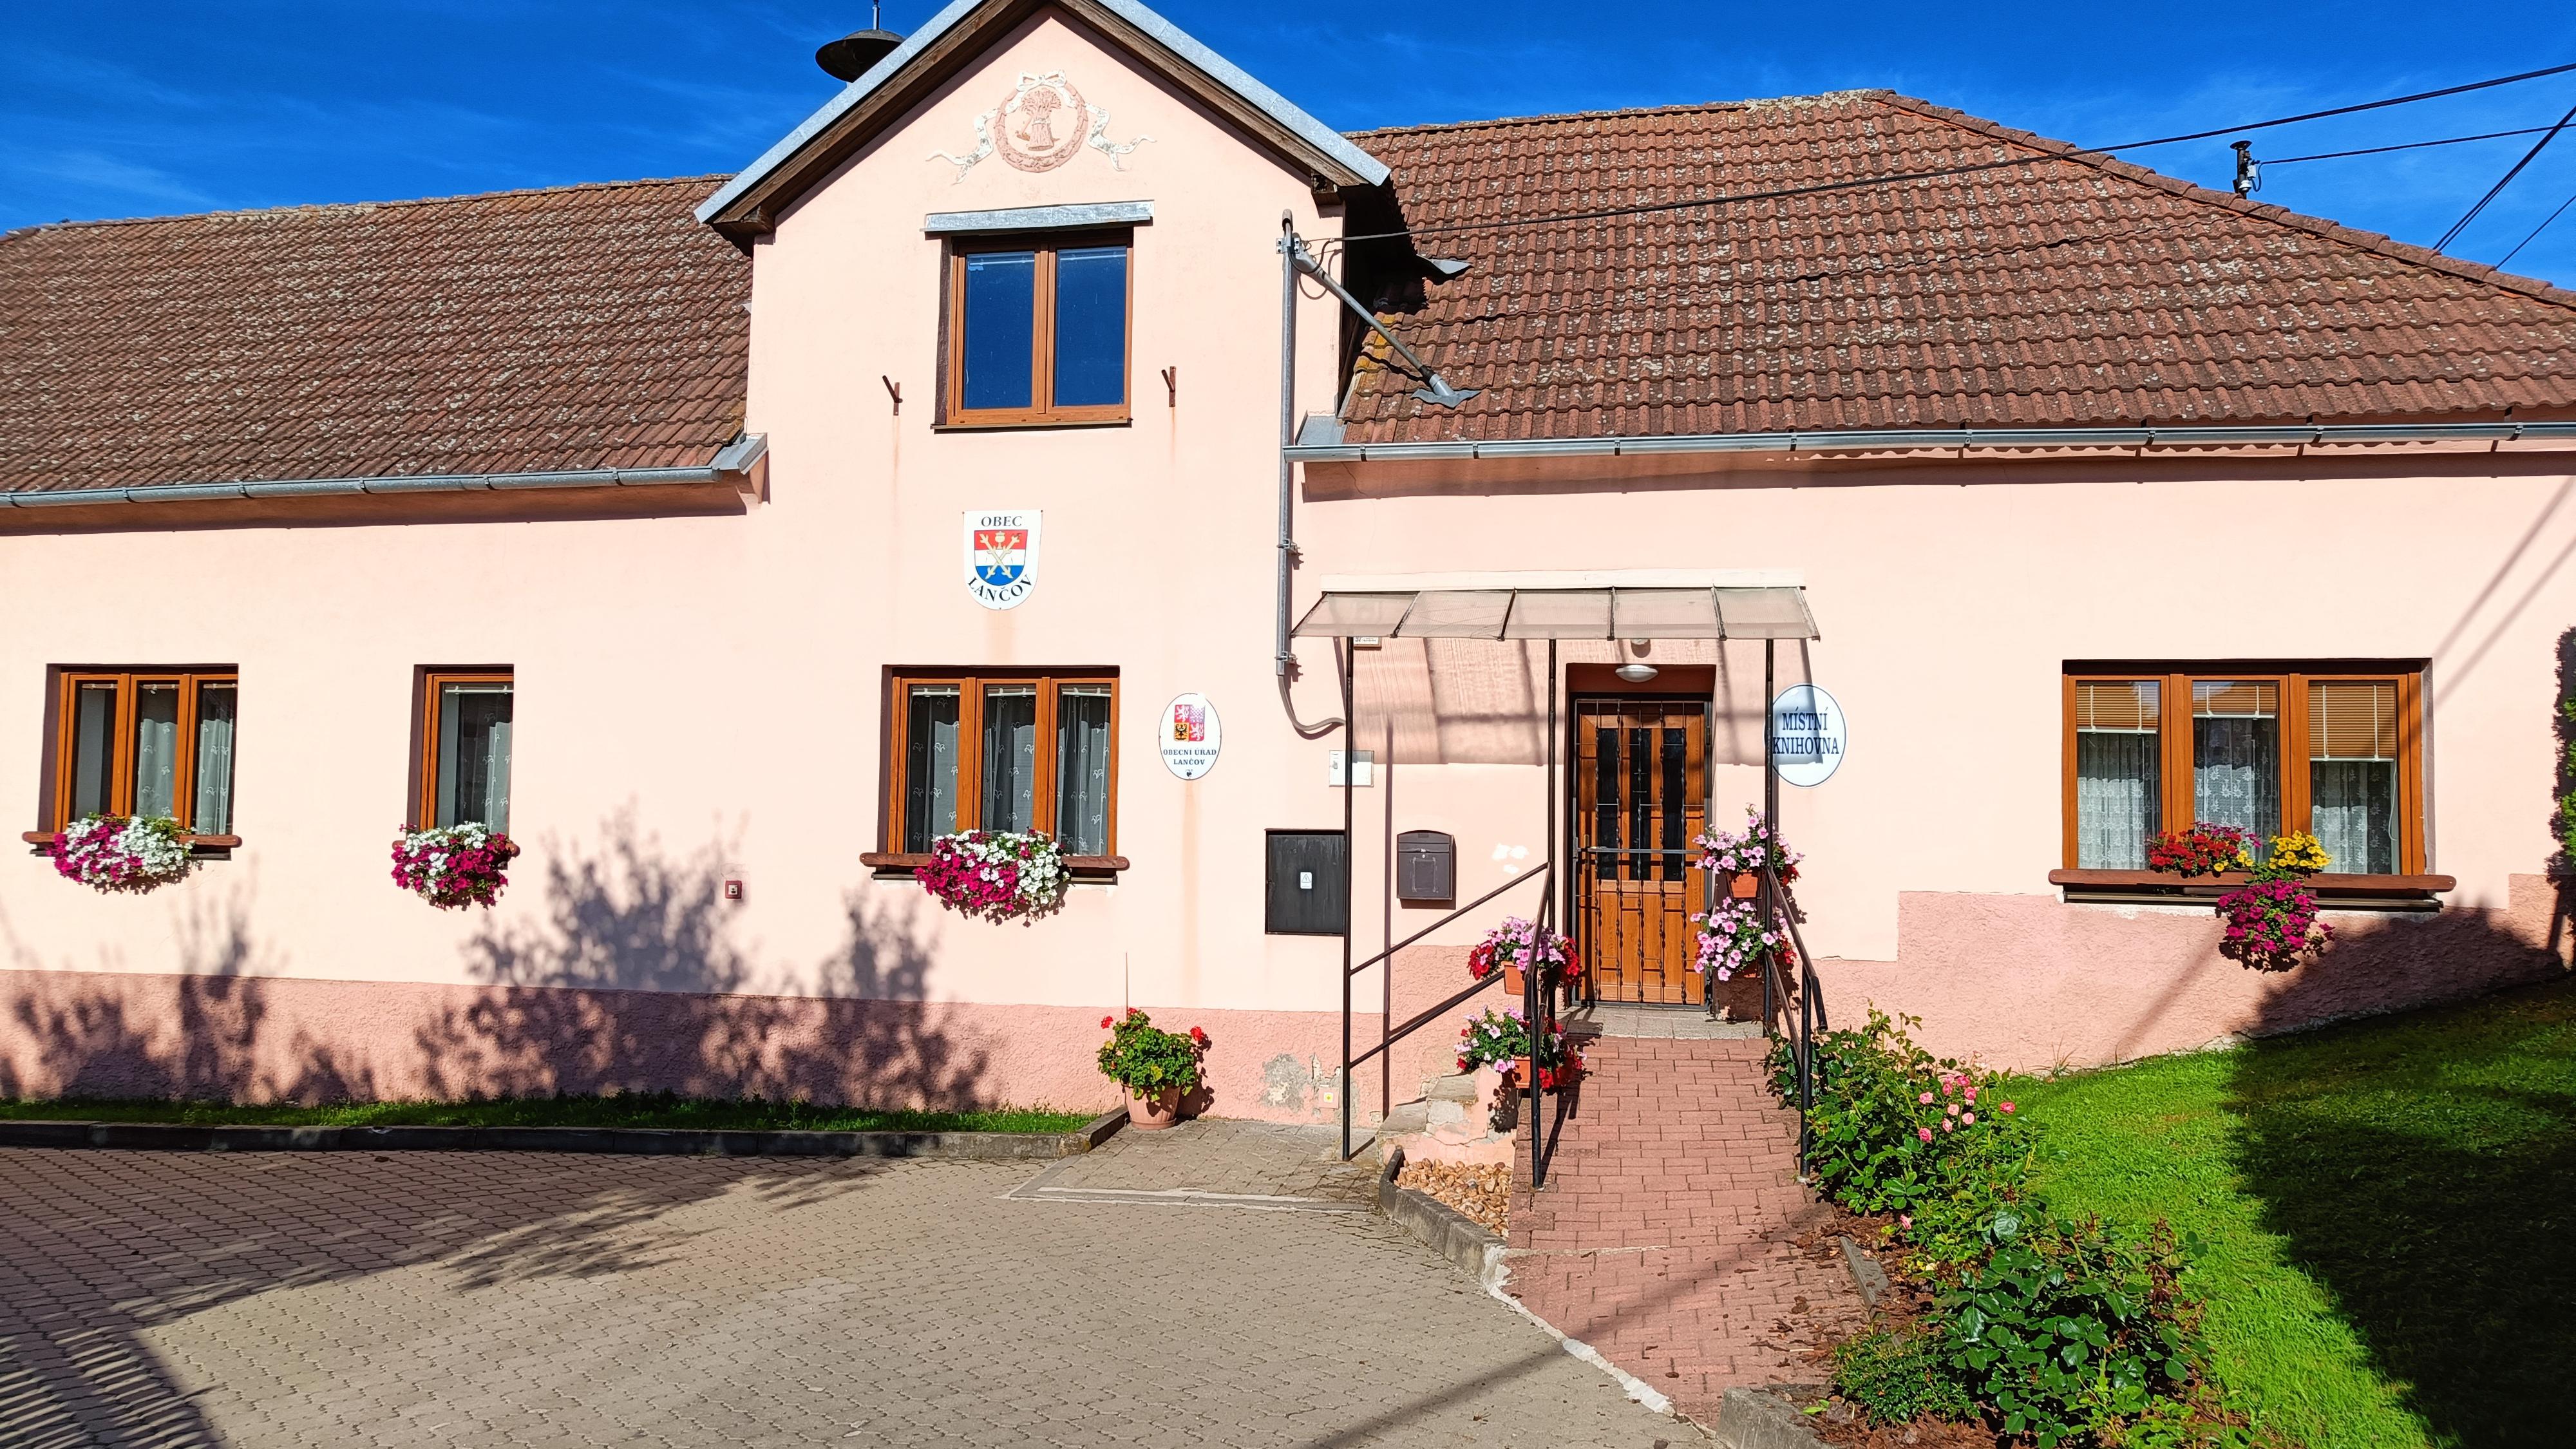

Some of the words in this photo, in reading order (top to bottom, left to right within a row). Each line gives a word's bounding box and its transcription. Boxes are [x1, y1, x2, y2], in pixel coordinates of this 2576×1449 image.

[981, 516, 1023, 527] OBEC
[967, 574, 1032, 601] LANČOV
[1782, 706, 1828, 730] MÍSTNÍ
[1772, 737, 1839, 755] KNIHOVNA
